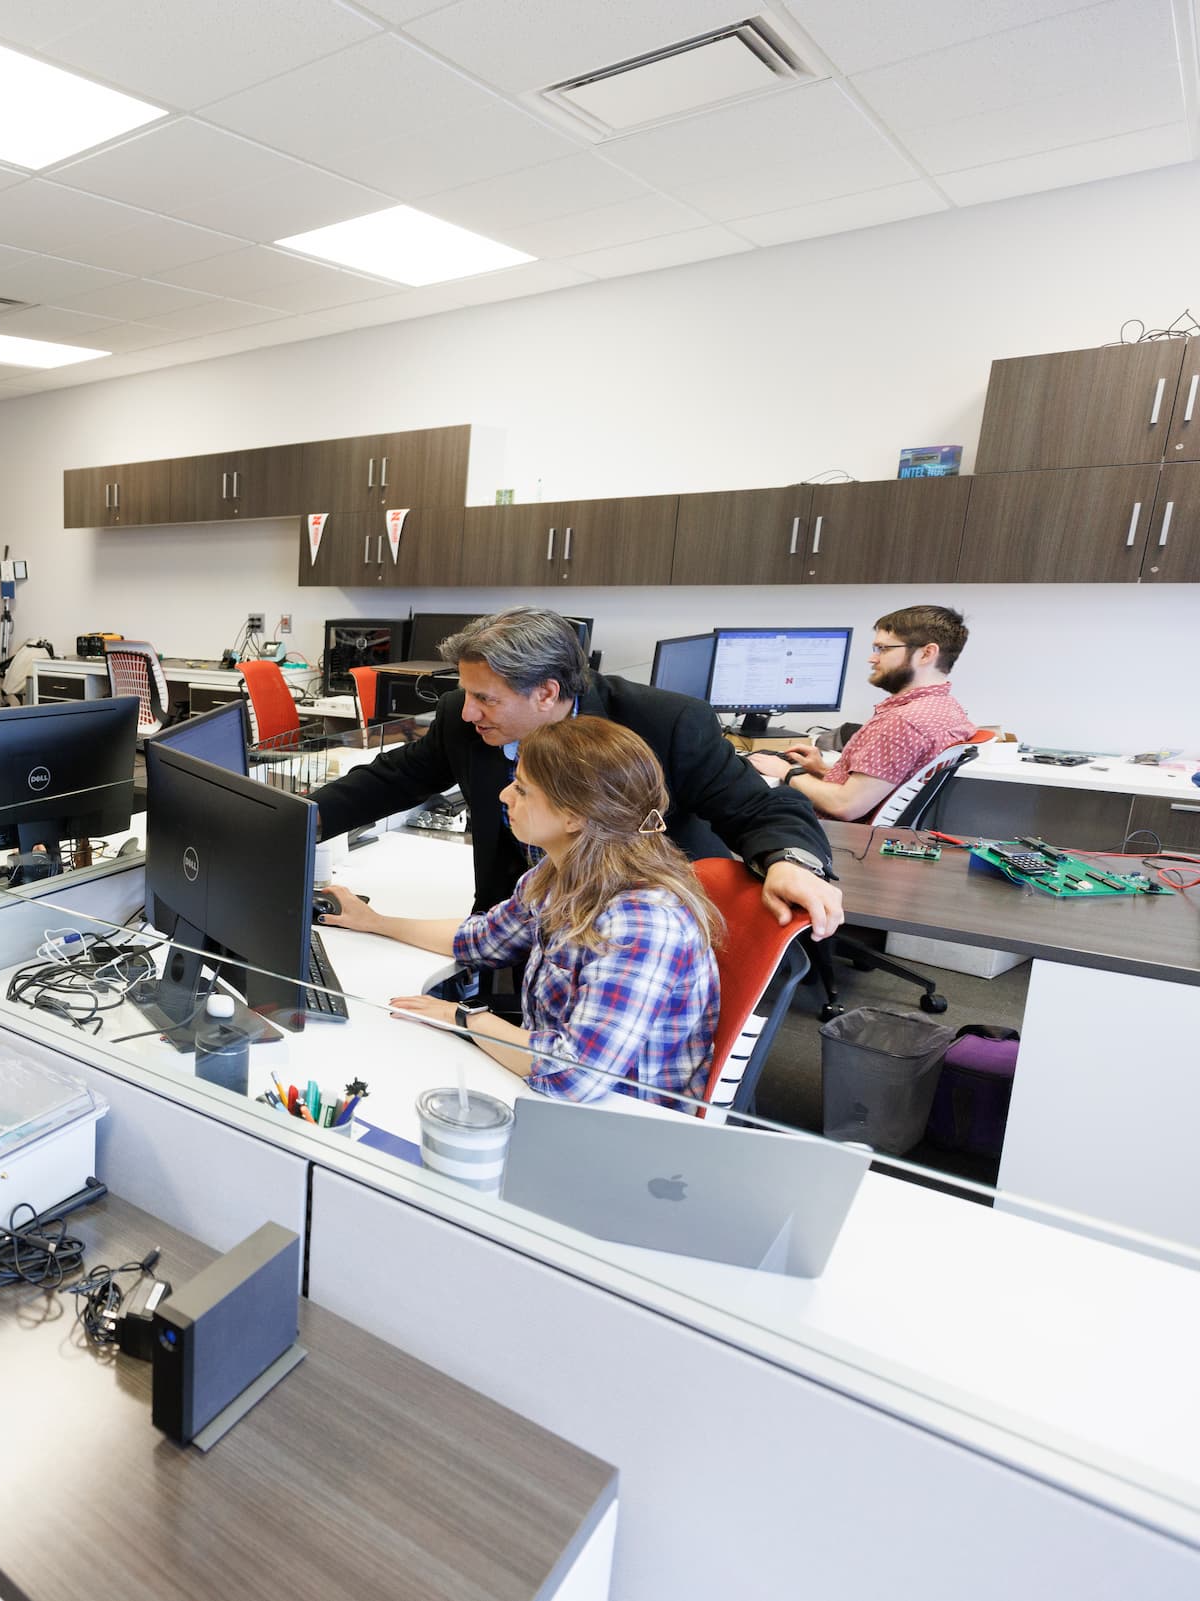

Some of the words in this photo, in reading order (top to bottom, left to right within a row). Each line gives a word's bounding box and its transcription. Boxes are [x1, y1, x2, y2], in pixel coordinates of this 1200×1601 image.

[901, 466, 925, 479] INTEL
[30, 775, 48, 783] DELL
[185, 857, 197, 871] DELL
